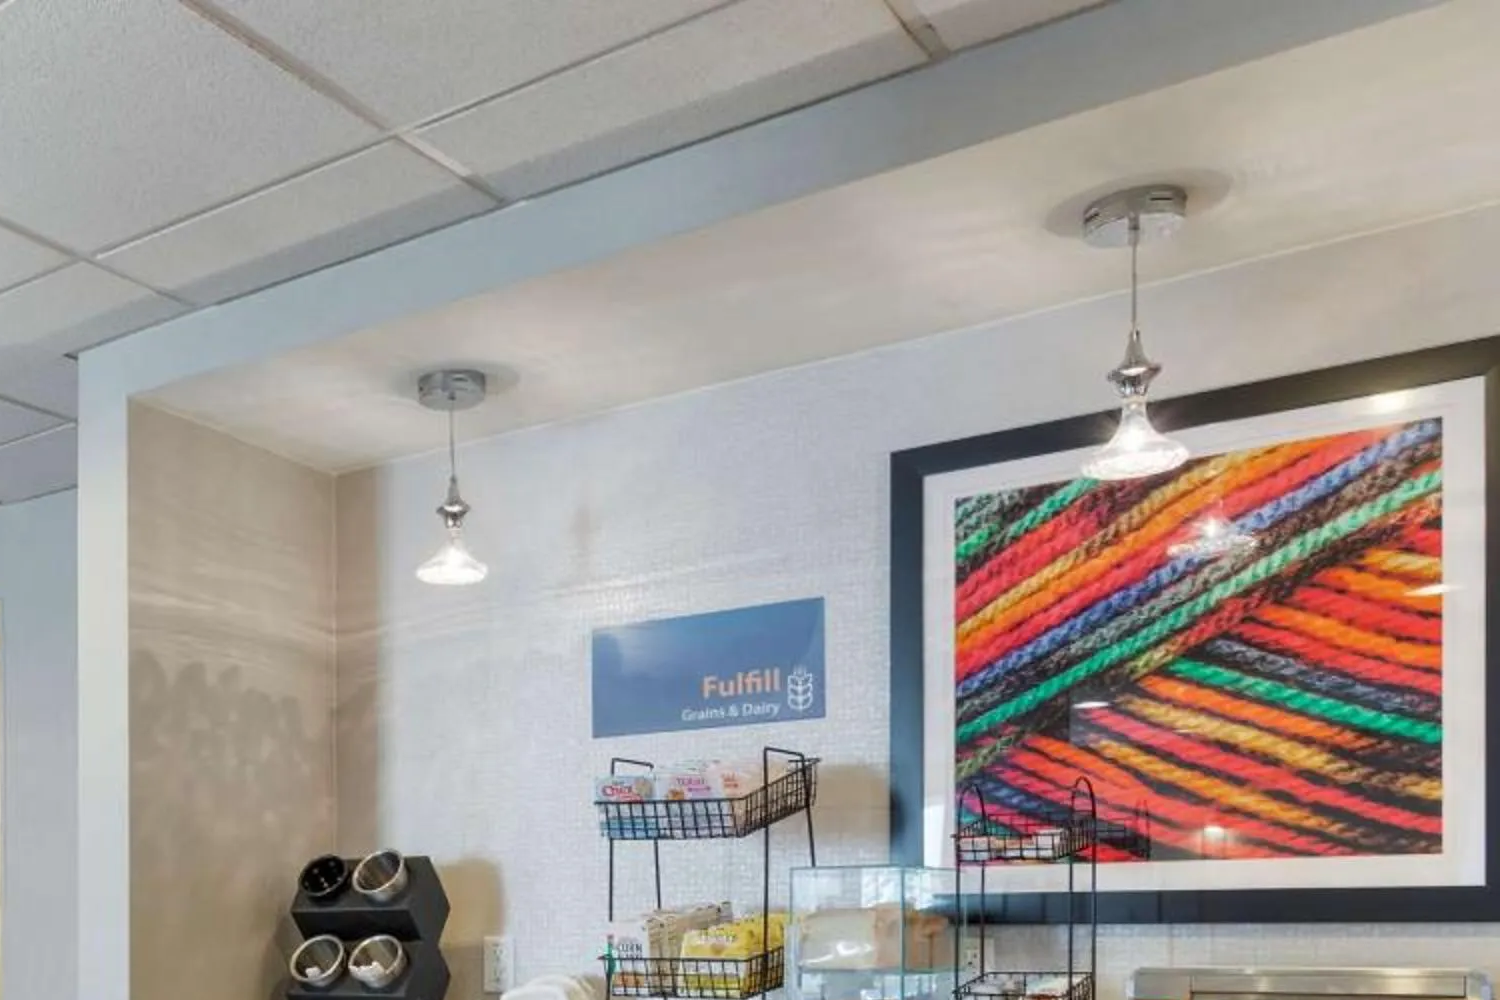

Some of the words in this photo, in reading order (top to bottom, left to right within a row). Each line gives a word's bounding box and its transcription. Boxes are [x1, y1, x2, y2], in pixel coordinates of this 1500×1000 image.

[703, 666, 780, 700] Fulfill
[681, 706, 725, 721] Grains
[728, 703, 739, 717] &
[742, 700, 779, 718] Dairy
